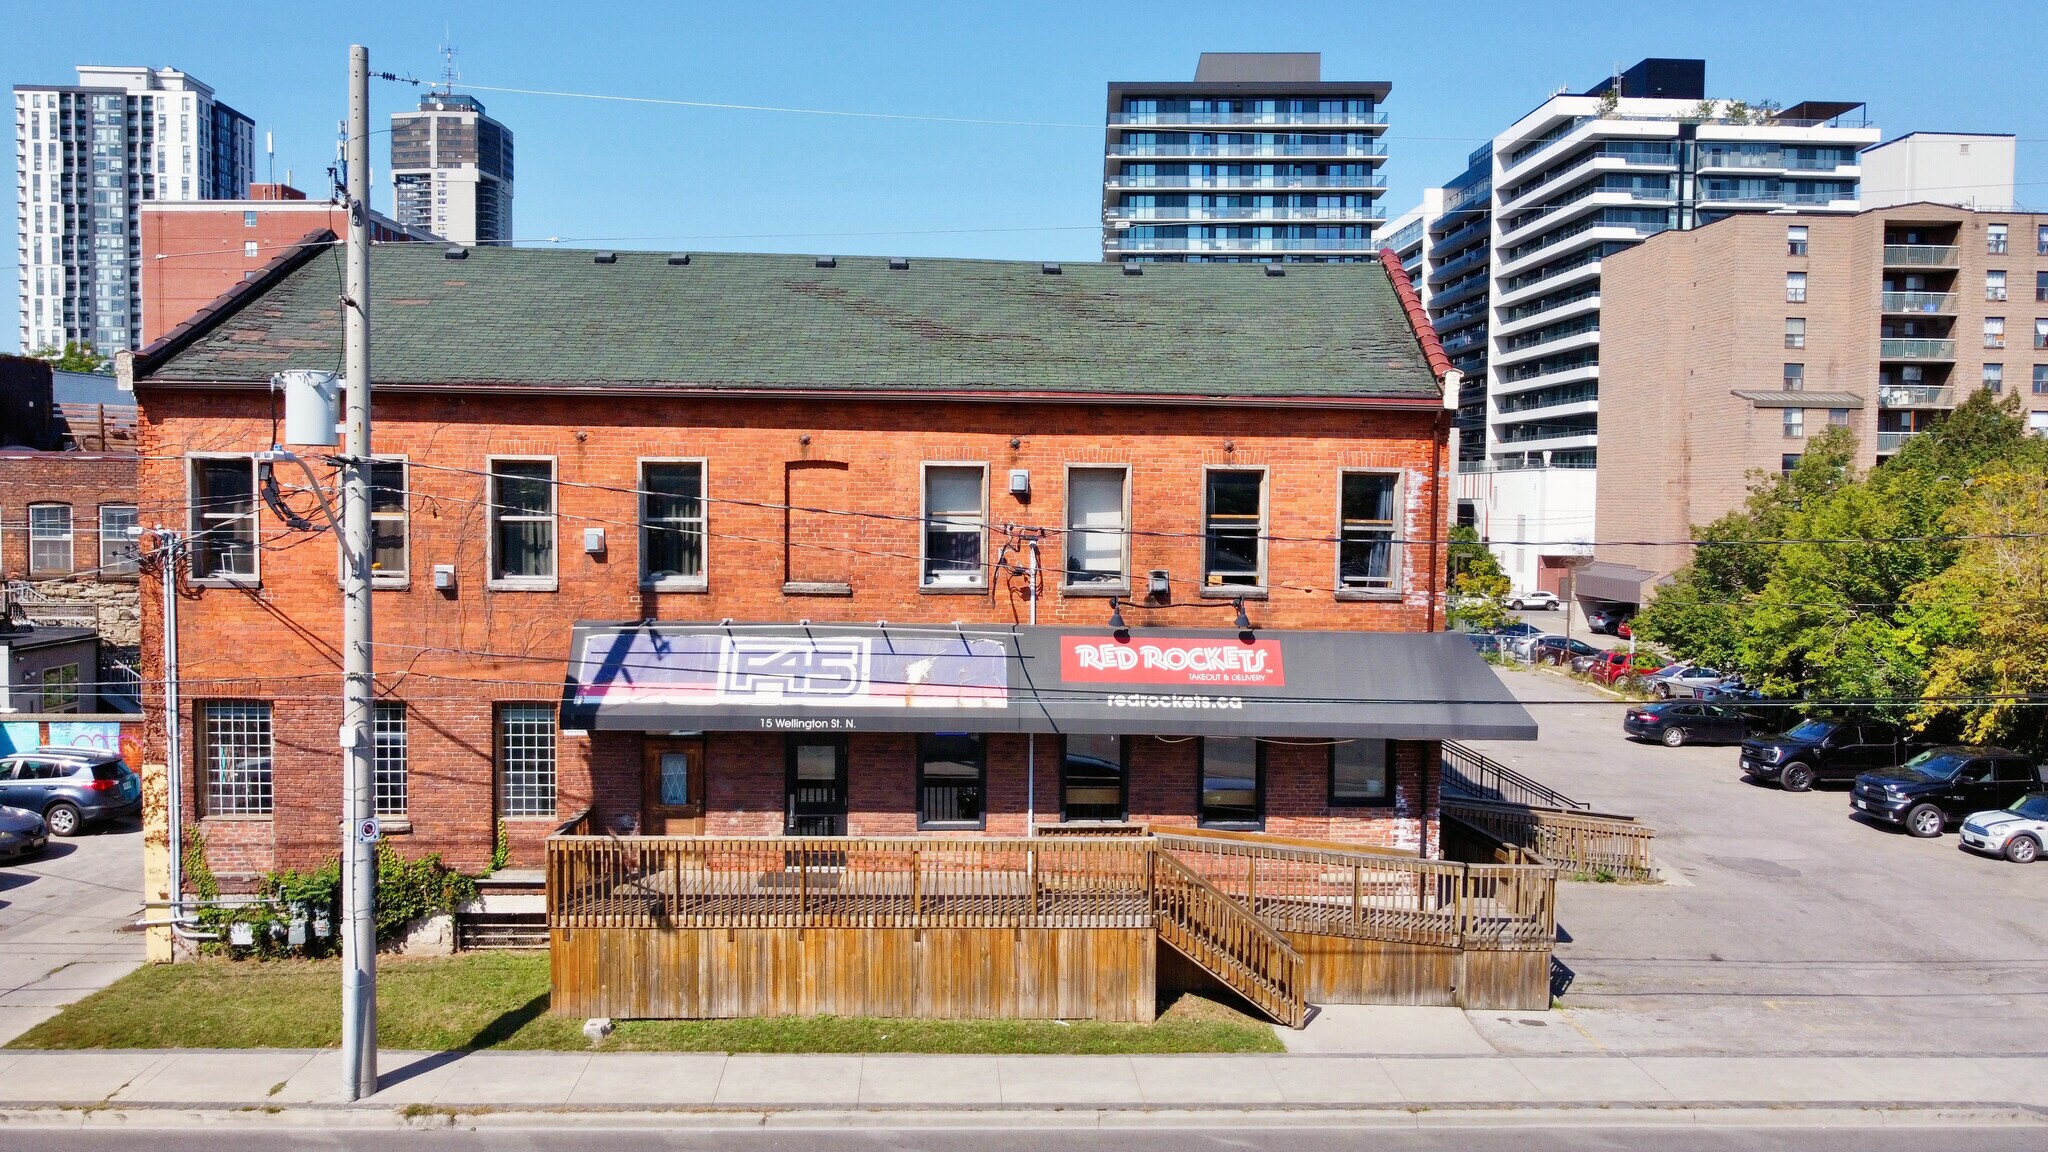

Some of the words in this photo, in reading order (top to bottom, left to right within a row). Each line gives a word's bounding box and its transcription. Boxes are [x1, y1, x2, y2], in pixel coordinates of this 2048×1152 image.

[1075, 644, 1138, 669] RED
[1139, 645, 1268, 672] ROCKETS
[726, 643, 861, 697] F45
[1188, 673, 1221, 681] TAKEOUT
[1223, 673, 1230, 681] &
[1232, 674, 1266, 682] DELIVERY
[1107, 694, 1242, 709] redrockets.ca
[760, 718, 773, 728] 15
[775, 718, 829, 730] Wellington
[830, 718, 843, 729] St.
[845, 719, 857, 729] N.
